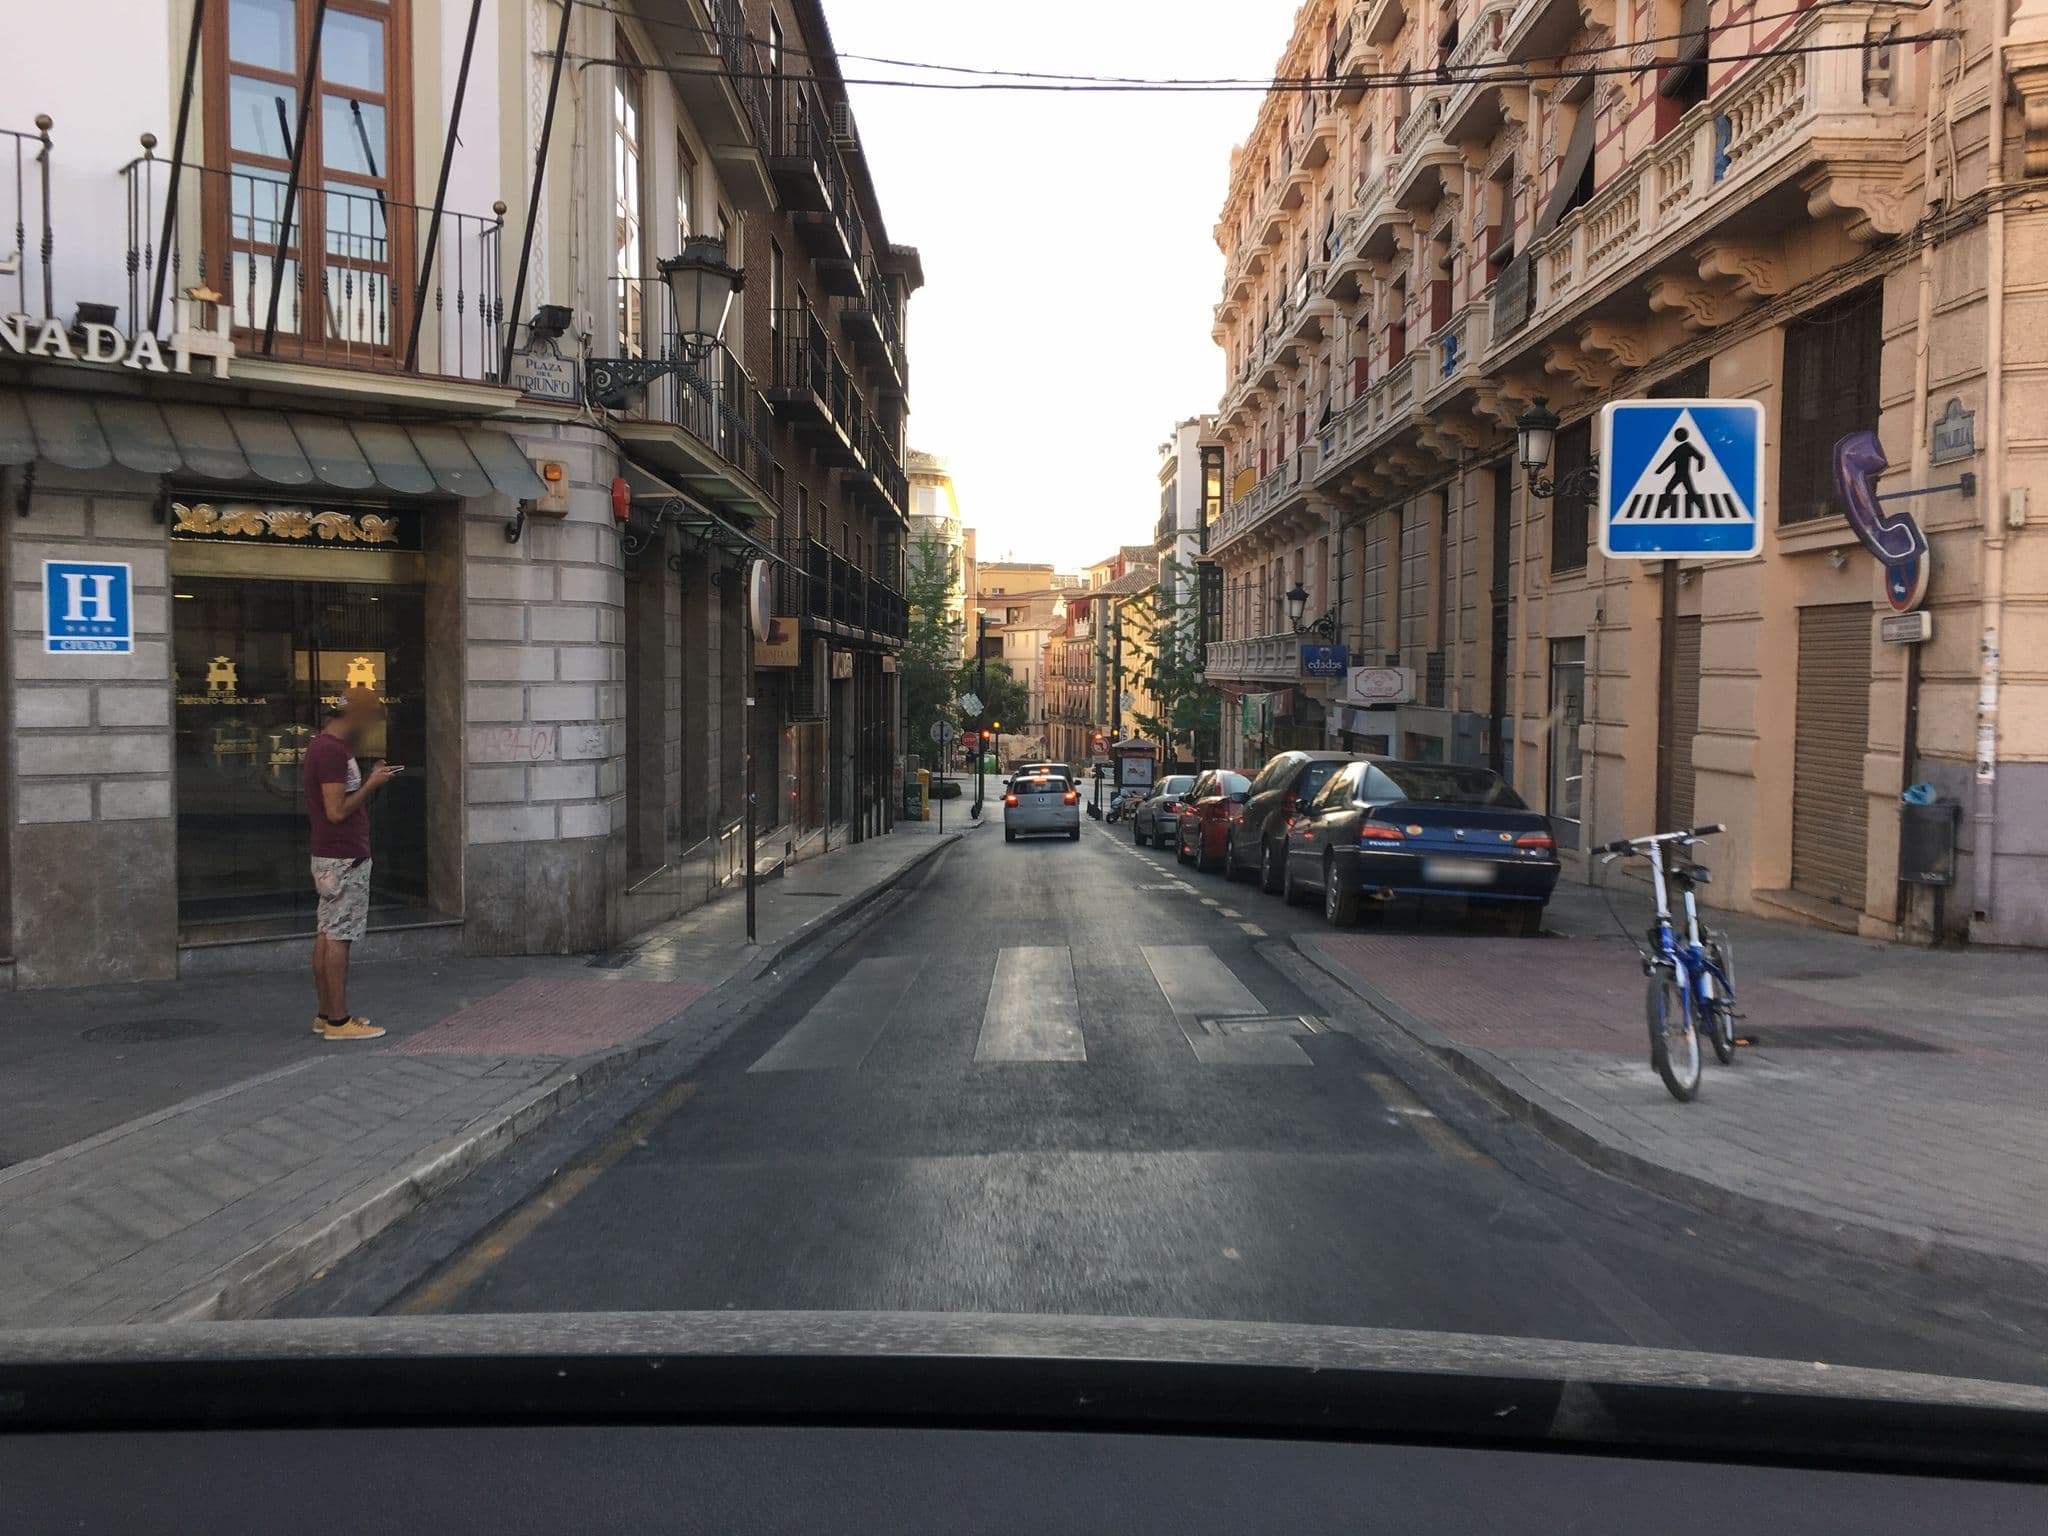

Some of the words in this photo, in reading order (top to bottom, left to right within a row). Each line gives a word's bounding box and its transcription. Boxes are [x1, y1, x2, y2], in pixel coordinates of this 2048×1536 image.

[526, 359, 563, 372] PLAZA
[516, 375, 570, 394] TRIUNFO
[61, 573, 117, 622] H
[60, 640, 117, 650] CIUDAD
